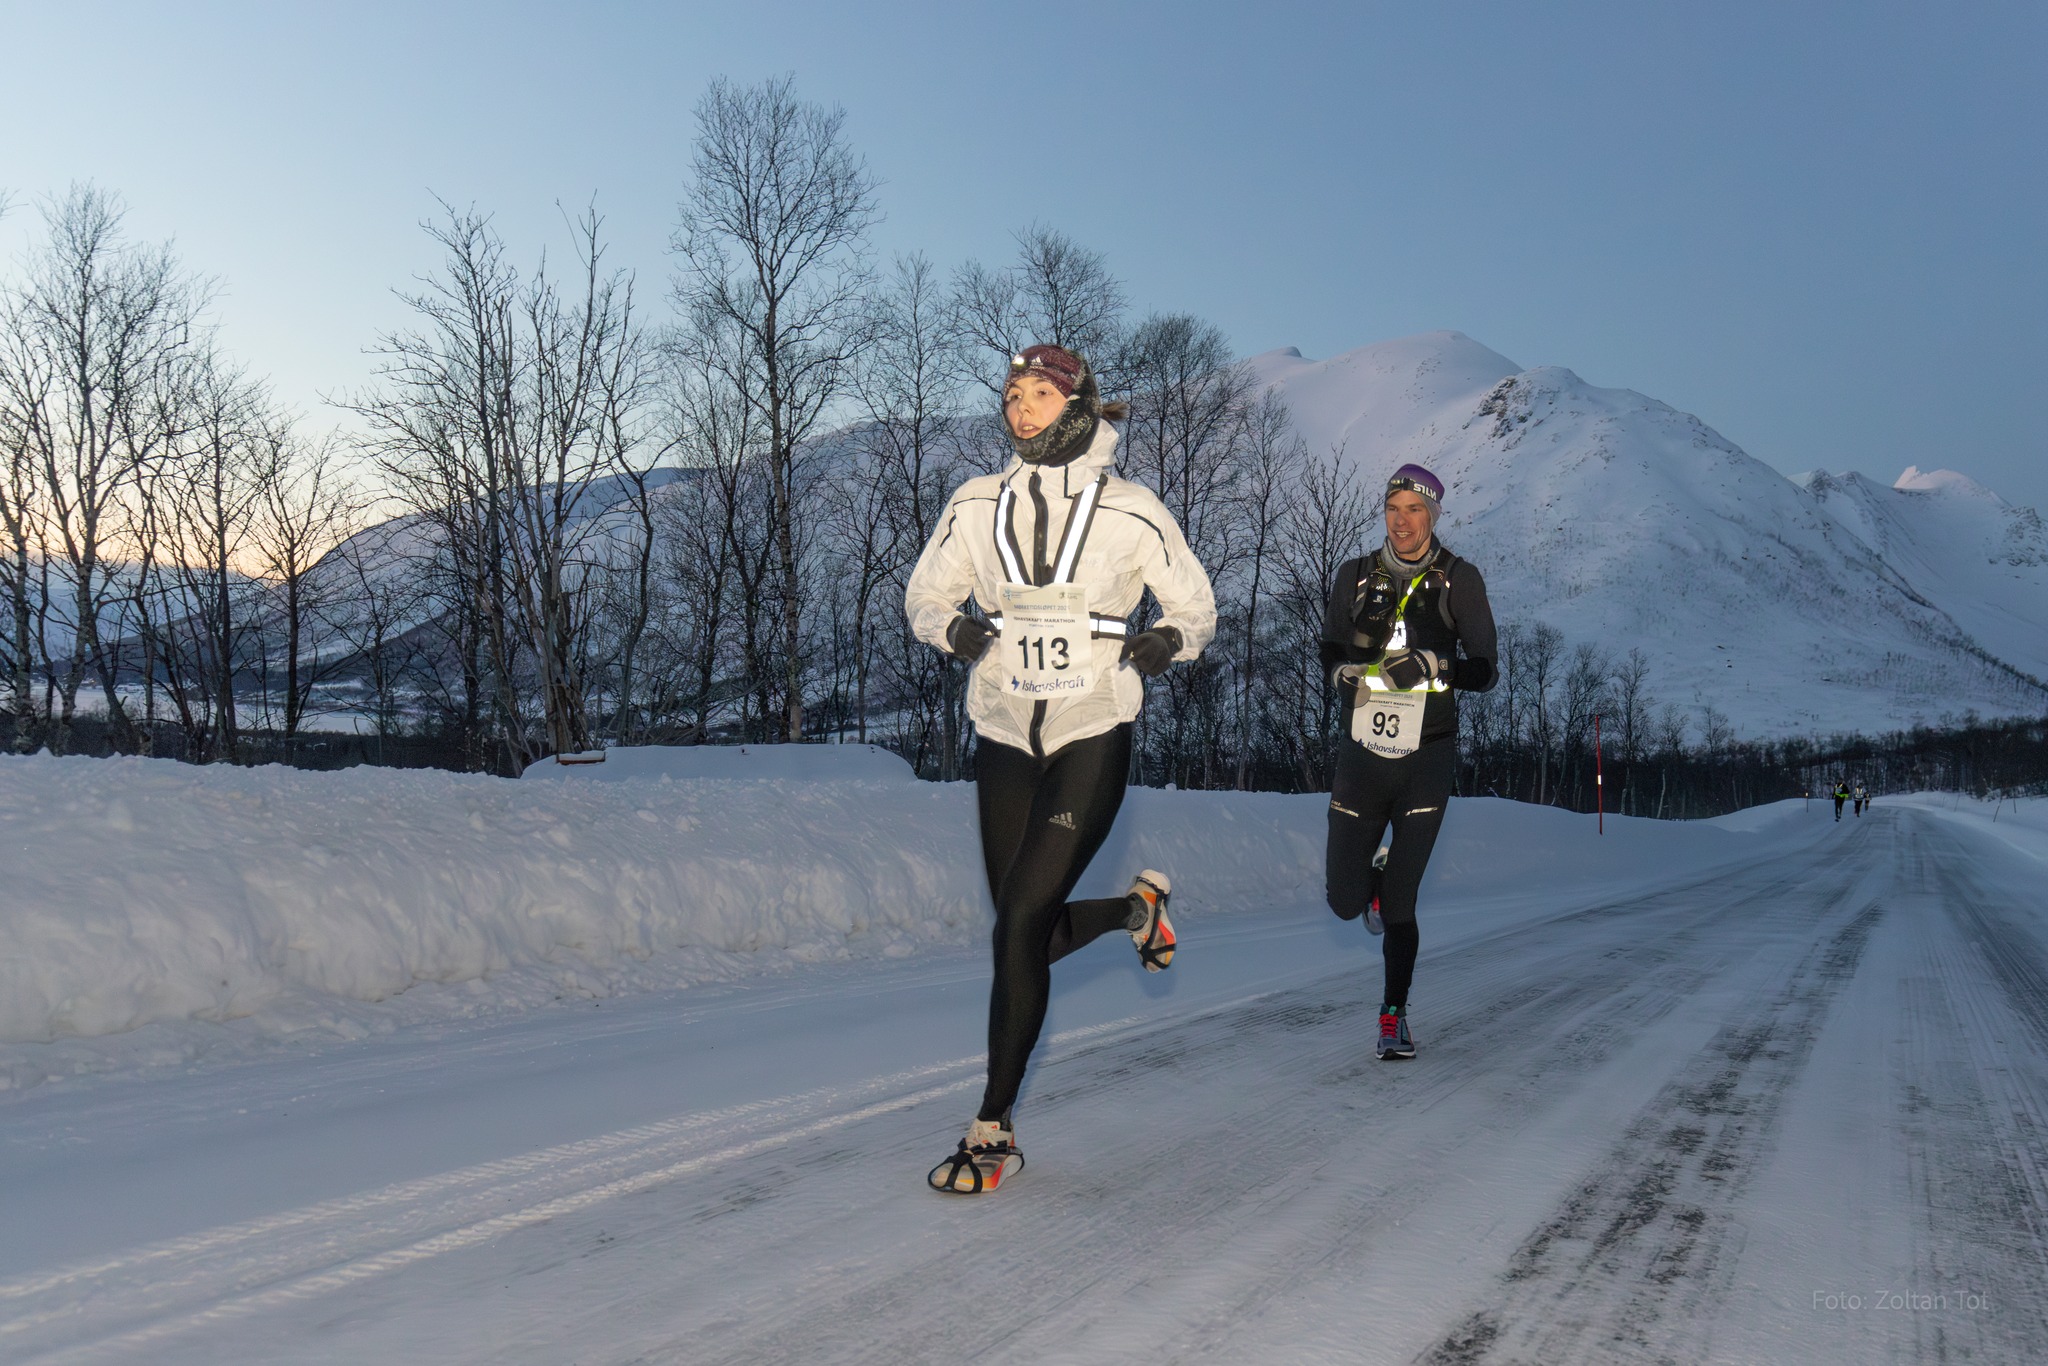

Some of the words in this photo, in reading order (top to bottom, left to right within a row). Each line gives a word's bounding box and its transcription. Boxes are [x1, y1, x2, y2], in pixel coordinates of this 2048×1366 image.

[1017, 635, 1070, 670] 113
[1021, 675, 1085, 693] Ishavskraft
[1372, 711, 1400, 738] 93
[1366, 741, 1414, 755] Ishavskraft
